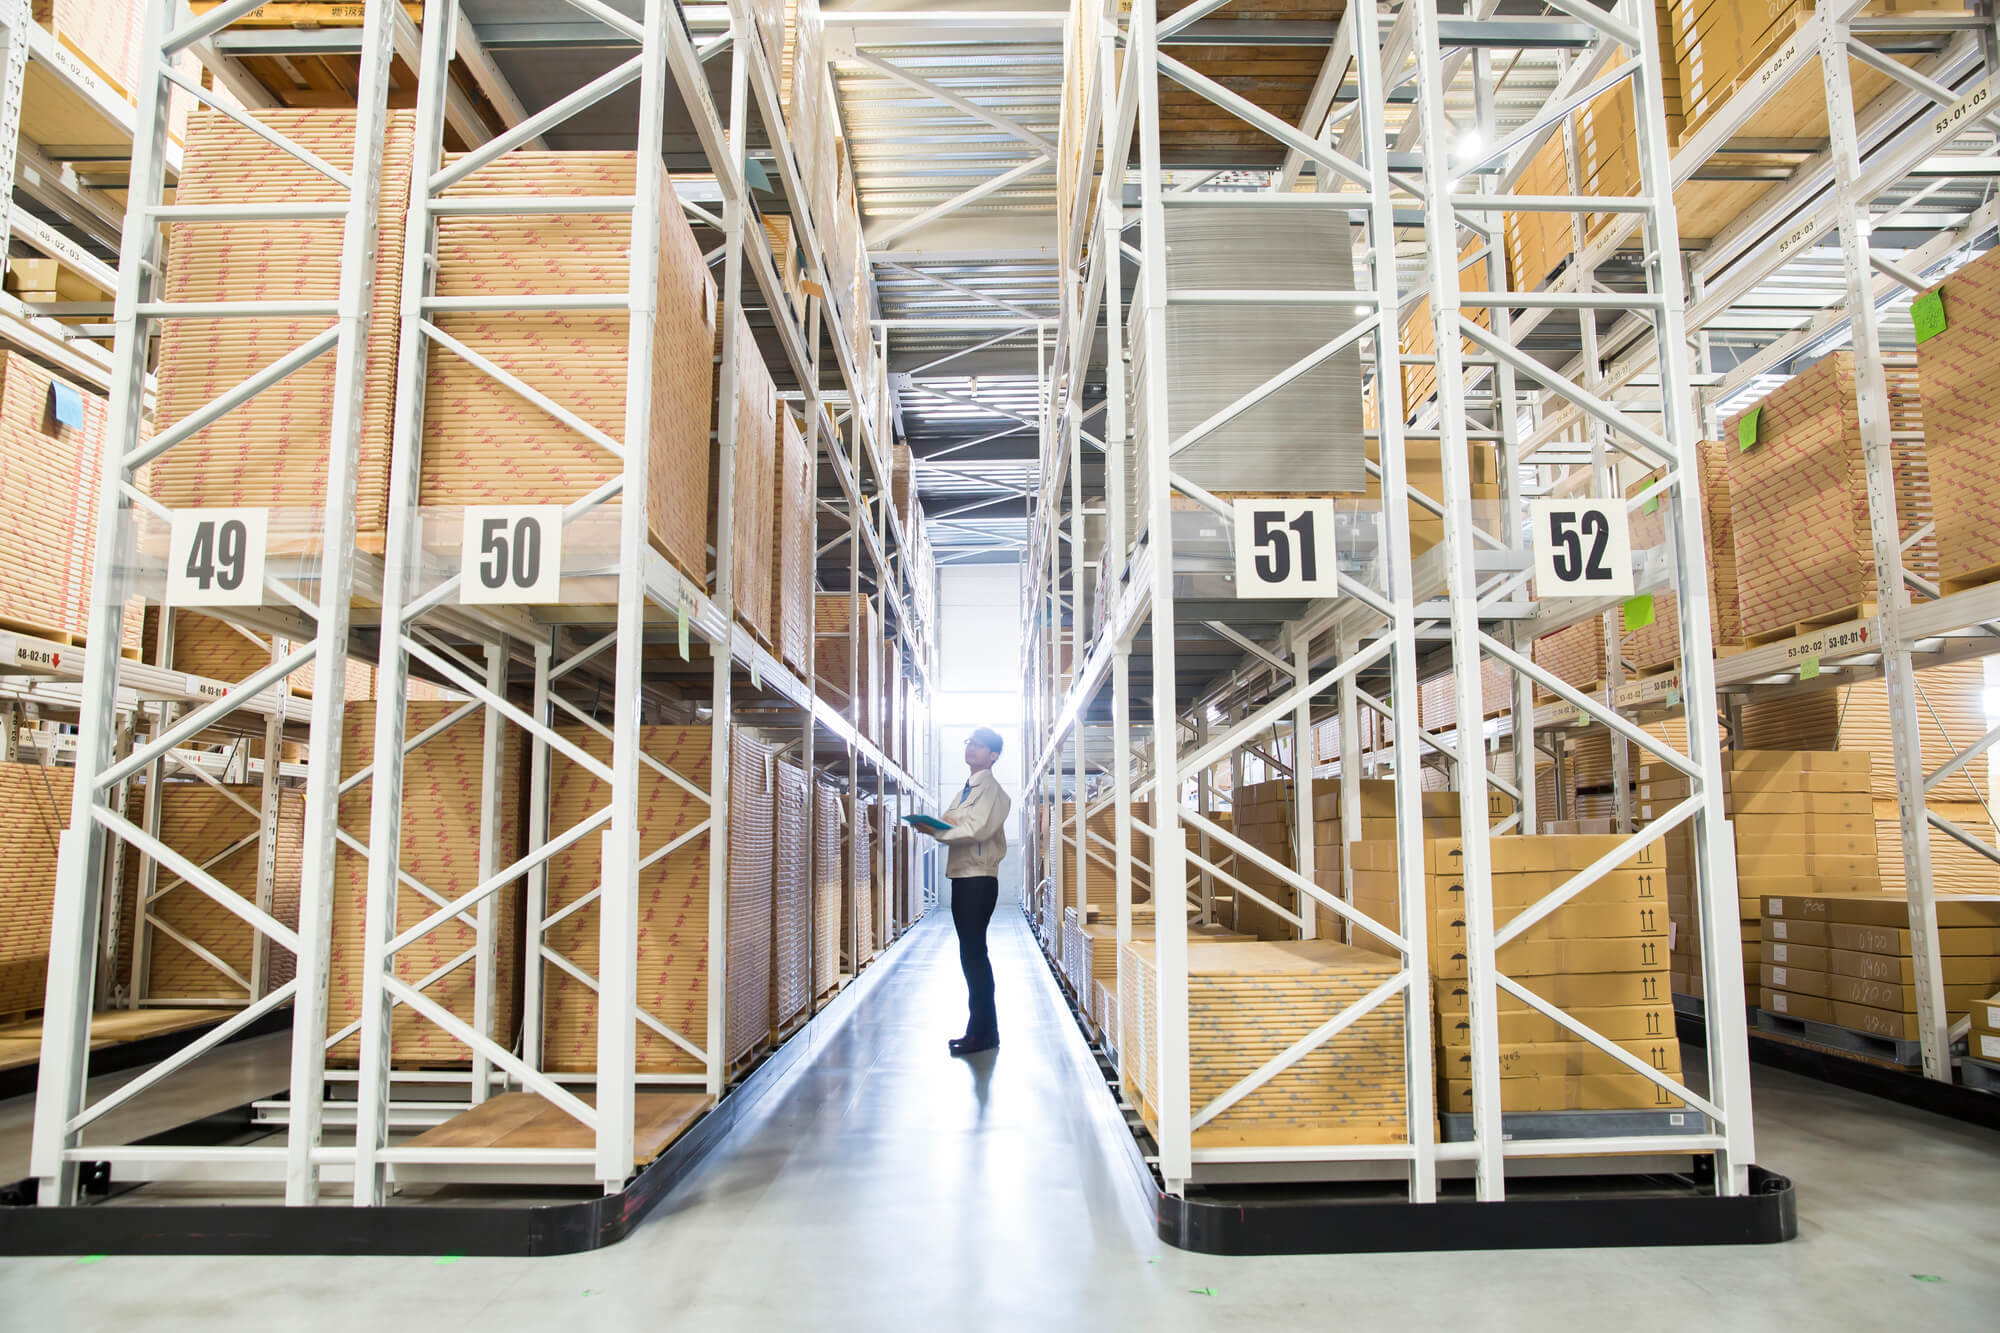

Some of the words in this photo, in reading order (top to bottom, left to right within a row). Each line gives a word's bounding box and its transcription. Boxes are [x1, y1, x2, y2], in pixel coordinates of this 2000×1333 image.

[1762, 46, 1795, 84] 53-02-04
[1936, 88, 1987, 134] 53-01-03
[39, 230, 80, 261] 48-02-03
[1779, 221, 1814, 252] 53-02-03
[186, 519, 248, 591] 49
[480, 516, 541, 589] 50
[1253, 510, 1317, 583] 51
[1550, 510, 1613, 582] 52
[17, 647, 51, 664] 48-02-01
[1788, 640, 1823, 658] 53-02-02
[1828, 631, 1859, 649] 53-02-01
